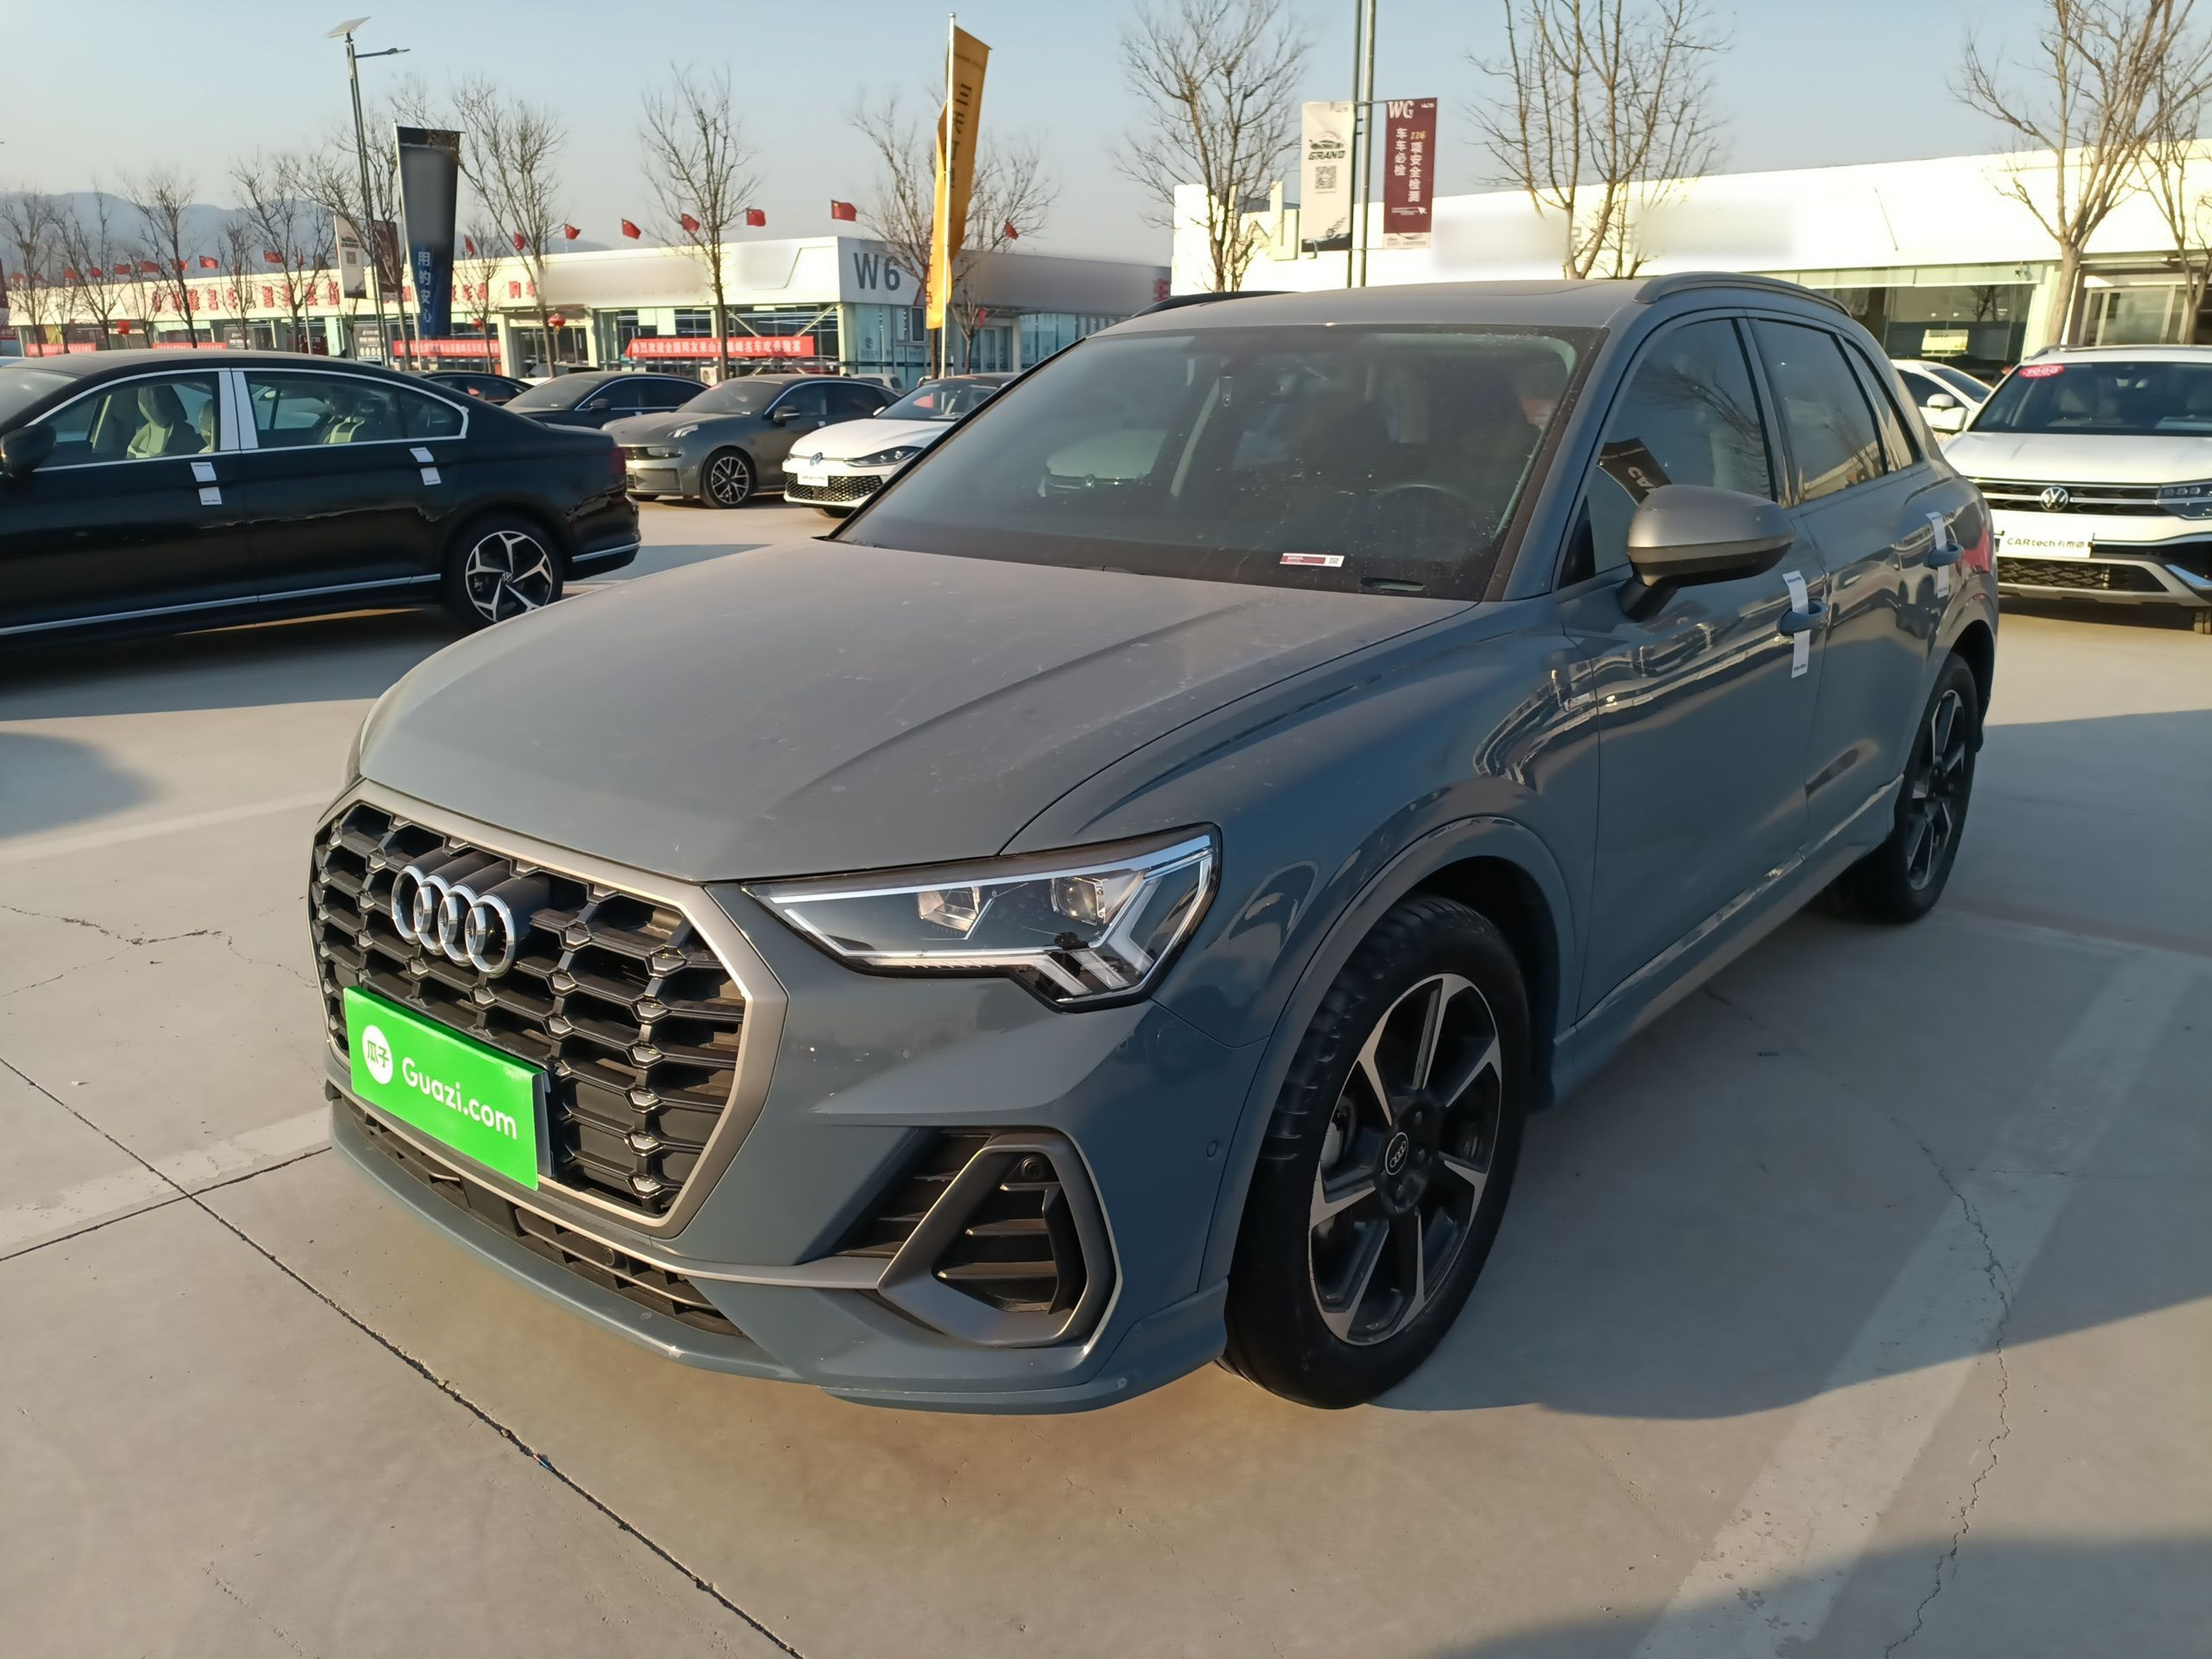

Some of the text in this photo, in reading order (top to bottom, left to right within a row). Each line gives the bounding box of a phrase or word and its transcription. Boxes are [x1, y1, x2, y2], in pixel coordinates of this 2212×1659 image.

[418, 251, 432, 323] 用的安心
[854, 252, 900, 291] W6
[367, 1040, 389, 1068] 瓜子
[402, 1057, 518, 1140] Guazi.com
